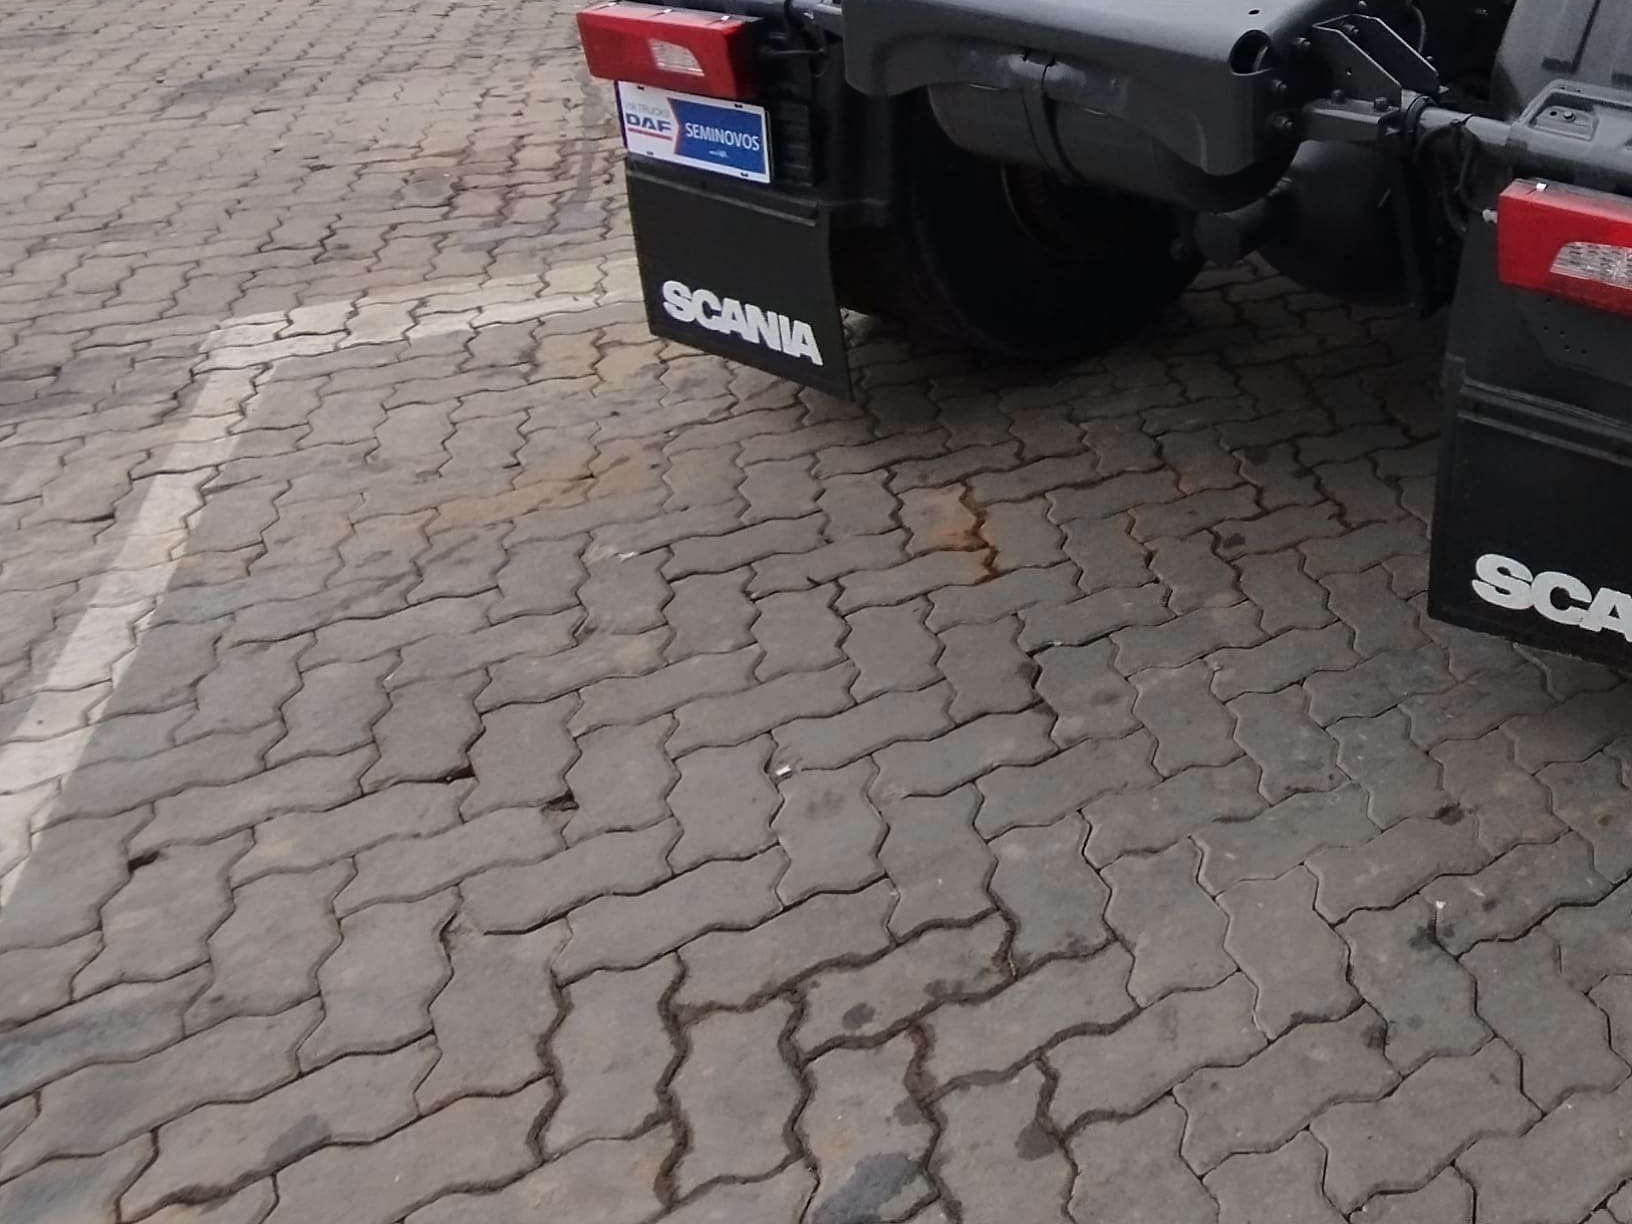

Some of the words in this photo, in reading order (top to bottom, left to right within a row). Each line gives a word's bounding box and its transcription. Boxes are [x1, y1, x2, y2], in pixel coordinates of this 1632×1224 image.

[625, 112, 672, 132] DAF
[685, 122, 760, 151] SEMINOVOS
[662, 279, 824, 367] SCANIA
